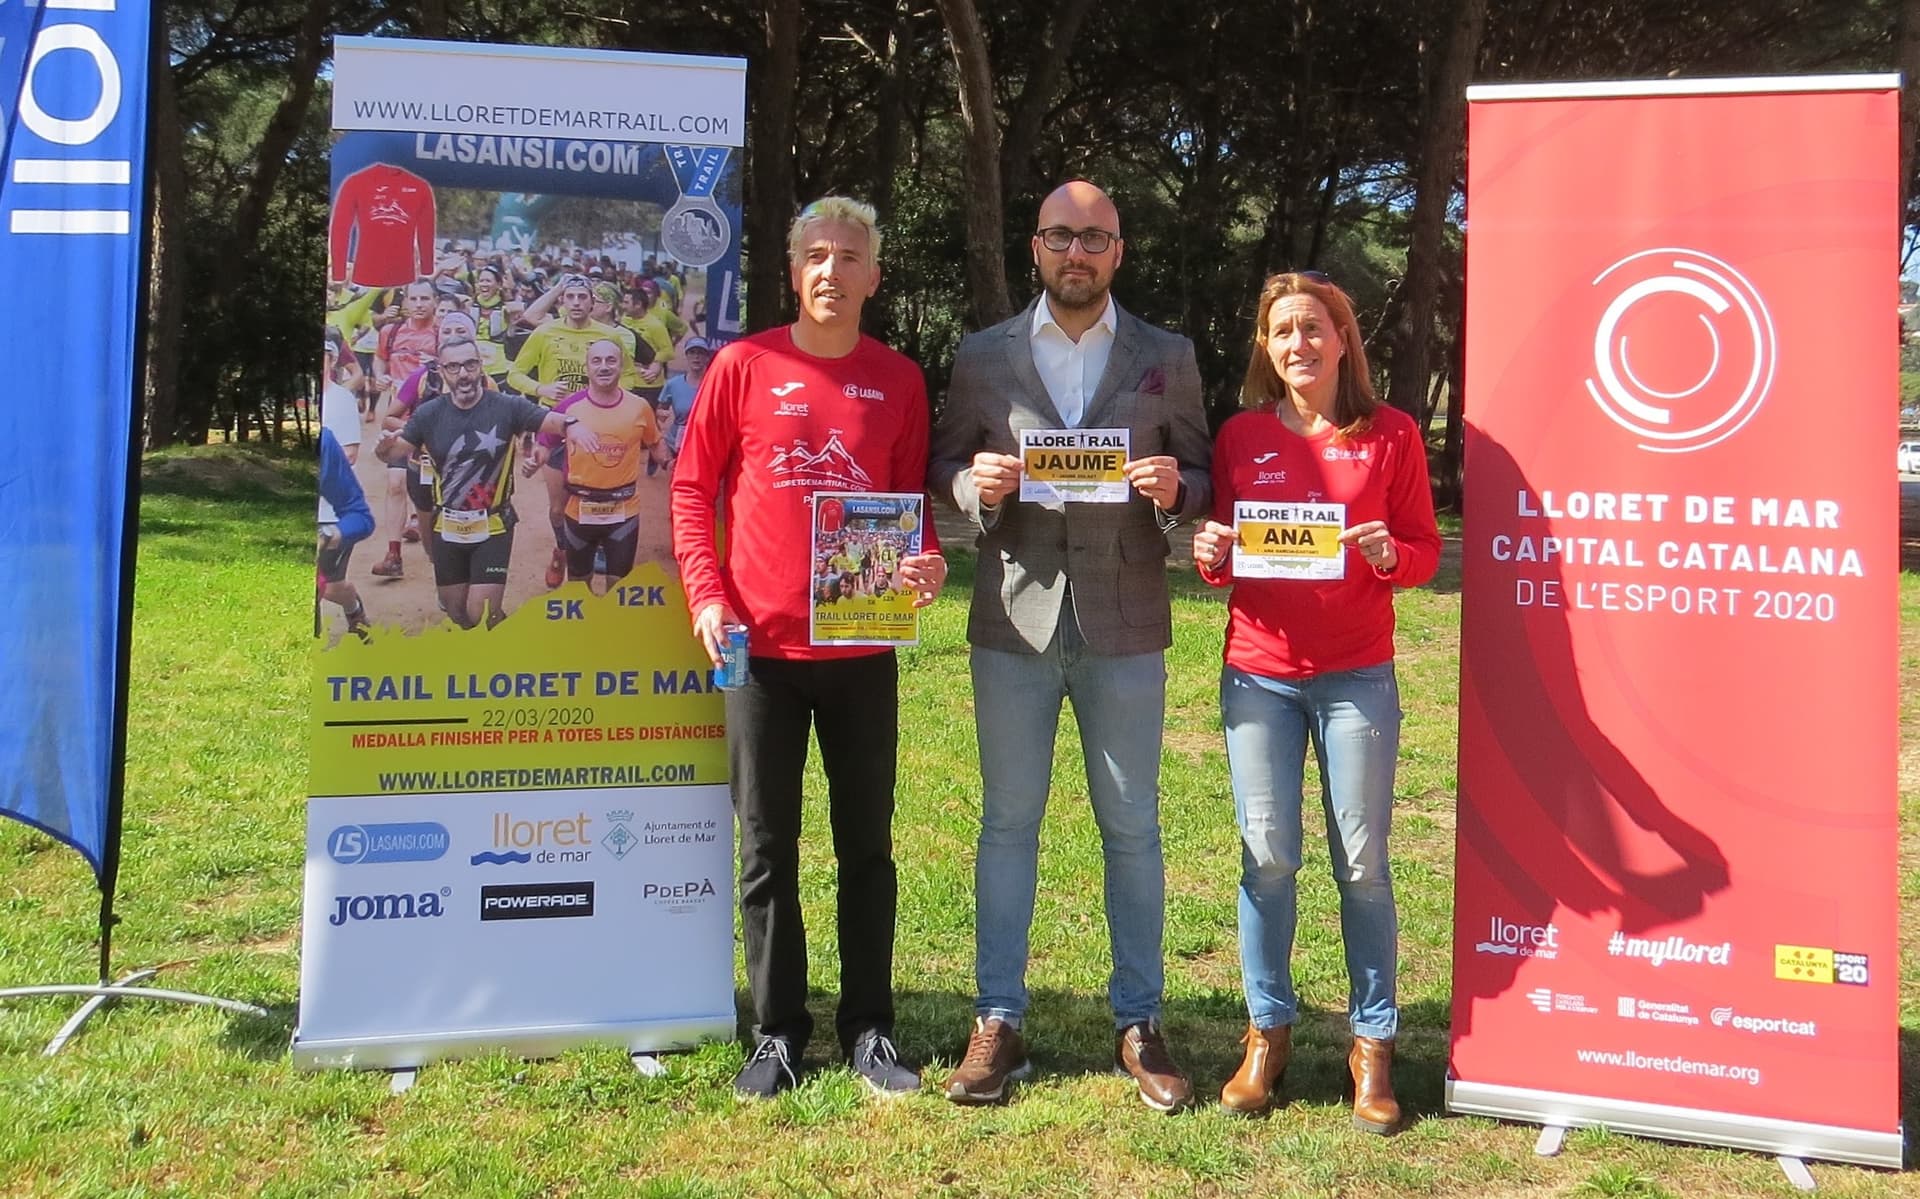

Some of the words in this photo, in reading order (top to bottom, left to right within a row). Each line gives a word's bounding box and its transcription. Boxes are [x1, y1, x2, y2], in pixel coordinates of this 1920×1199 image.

[10, 0, 131, 234] llo
[354, 100, 729, 135] WWW.LLORETDEMARTRAIL.COM
[416, 133, 640, 175] LASANSI.COM
[694, 152, 720, 191] TRAIL
[780, 400, 809, 413] lloret
[1034, 454, 1117, 471] JAUME
[1258, 470, 1286, 481] lloret
[1518, 490, 1669, 522] LLORET
[1685, 495, 1734, 525] DE
[1752, 498, 1840, 529] MAR
[1263, 528, 1315, 546] ANA
[1492, 535, 1644, 567] CAPITAL
[1658, 541, 1864, 577] CATALANA
[616, 586, 665, 606] 12K
[1516, 580, 1560, 607] DE
[1753, 590, 1834, 621] 2020
[546, 600, 584, 620] 5K
[816, 611, 841, 621] TRAIL
[843, 611, 876, 621] LLORET
[879, 612, 891, 621] DE
[893, 612, 914, 621] MAR
[327, 675, 433, 701] TRAIL
[448, 672, 582, 699] LLORET
[596, 670, 639, 696] DE
[482, 708, 594, 730] 22/03/2020
[352, 732, 426, 748] MEDALLA
[431, 731, 503, 746] FINISHER
[508, 729, 538, 745] PER
[543, 729, 553, 743] A
[558, 727, 603, 742] TOTES
[607, 726, 635, 741] LES
[639, 722, 725, 741] DISTÀNCIES
[379, 764, 696, 791] WWW.LLORETDEMARTRAIL.COM
[494, 812, 592, 848] lloret
[644, 821, 702, 833] Ajuntament
[704, 819, 717, 829] de
[334, 832, 362, 857] LS
[371, 833, 445, 852] LASANSI.COM
[644, 834, 675, 845] Lloret
[679, 833, 691, 844] de
[695, 833, 716, 843] Mar
[536, 850, 555, 864] de
[560, 850, 592, 863] mar
[485, 893, 589, 909] POWERADE
[1491, 917, 1559, 948] lloret
[1520, 946, 1535, 957] de
[1535, 948, 1557, 960] mar
[1608, 931, 1732, 967] #mylloret
[1780, 958, 1828, 969] CATALUNYA
[1638, 1000, 1689, 1013] Generalitat
[1638, 1011, 1649, 1020] de
[1652, 1012, 1699, 1025] Catalunya
[1732, 1013, 1816, 1037] esportcat
[1577, 1049, 1760, 1085] www.lloretdemar.org
